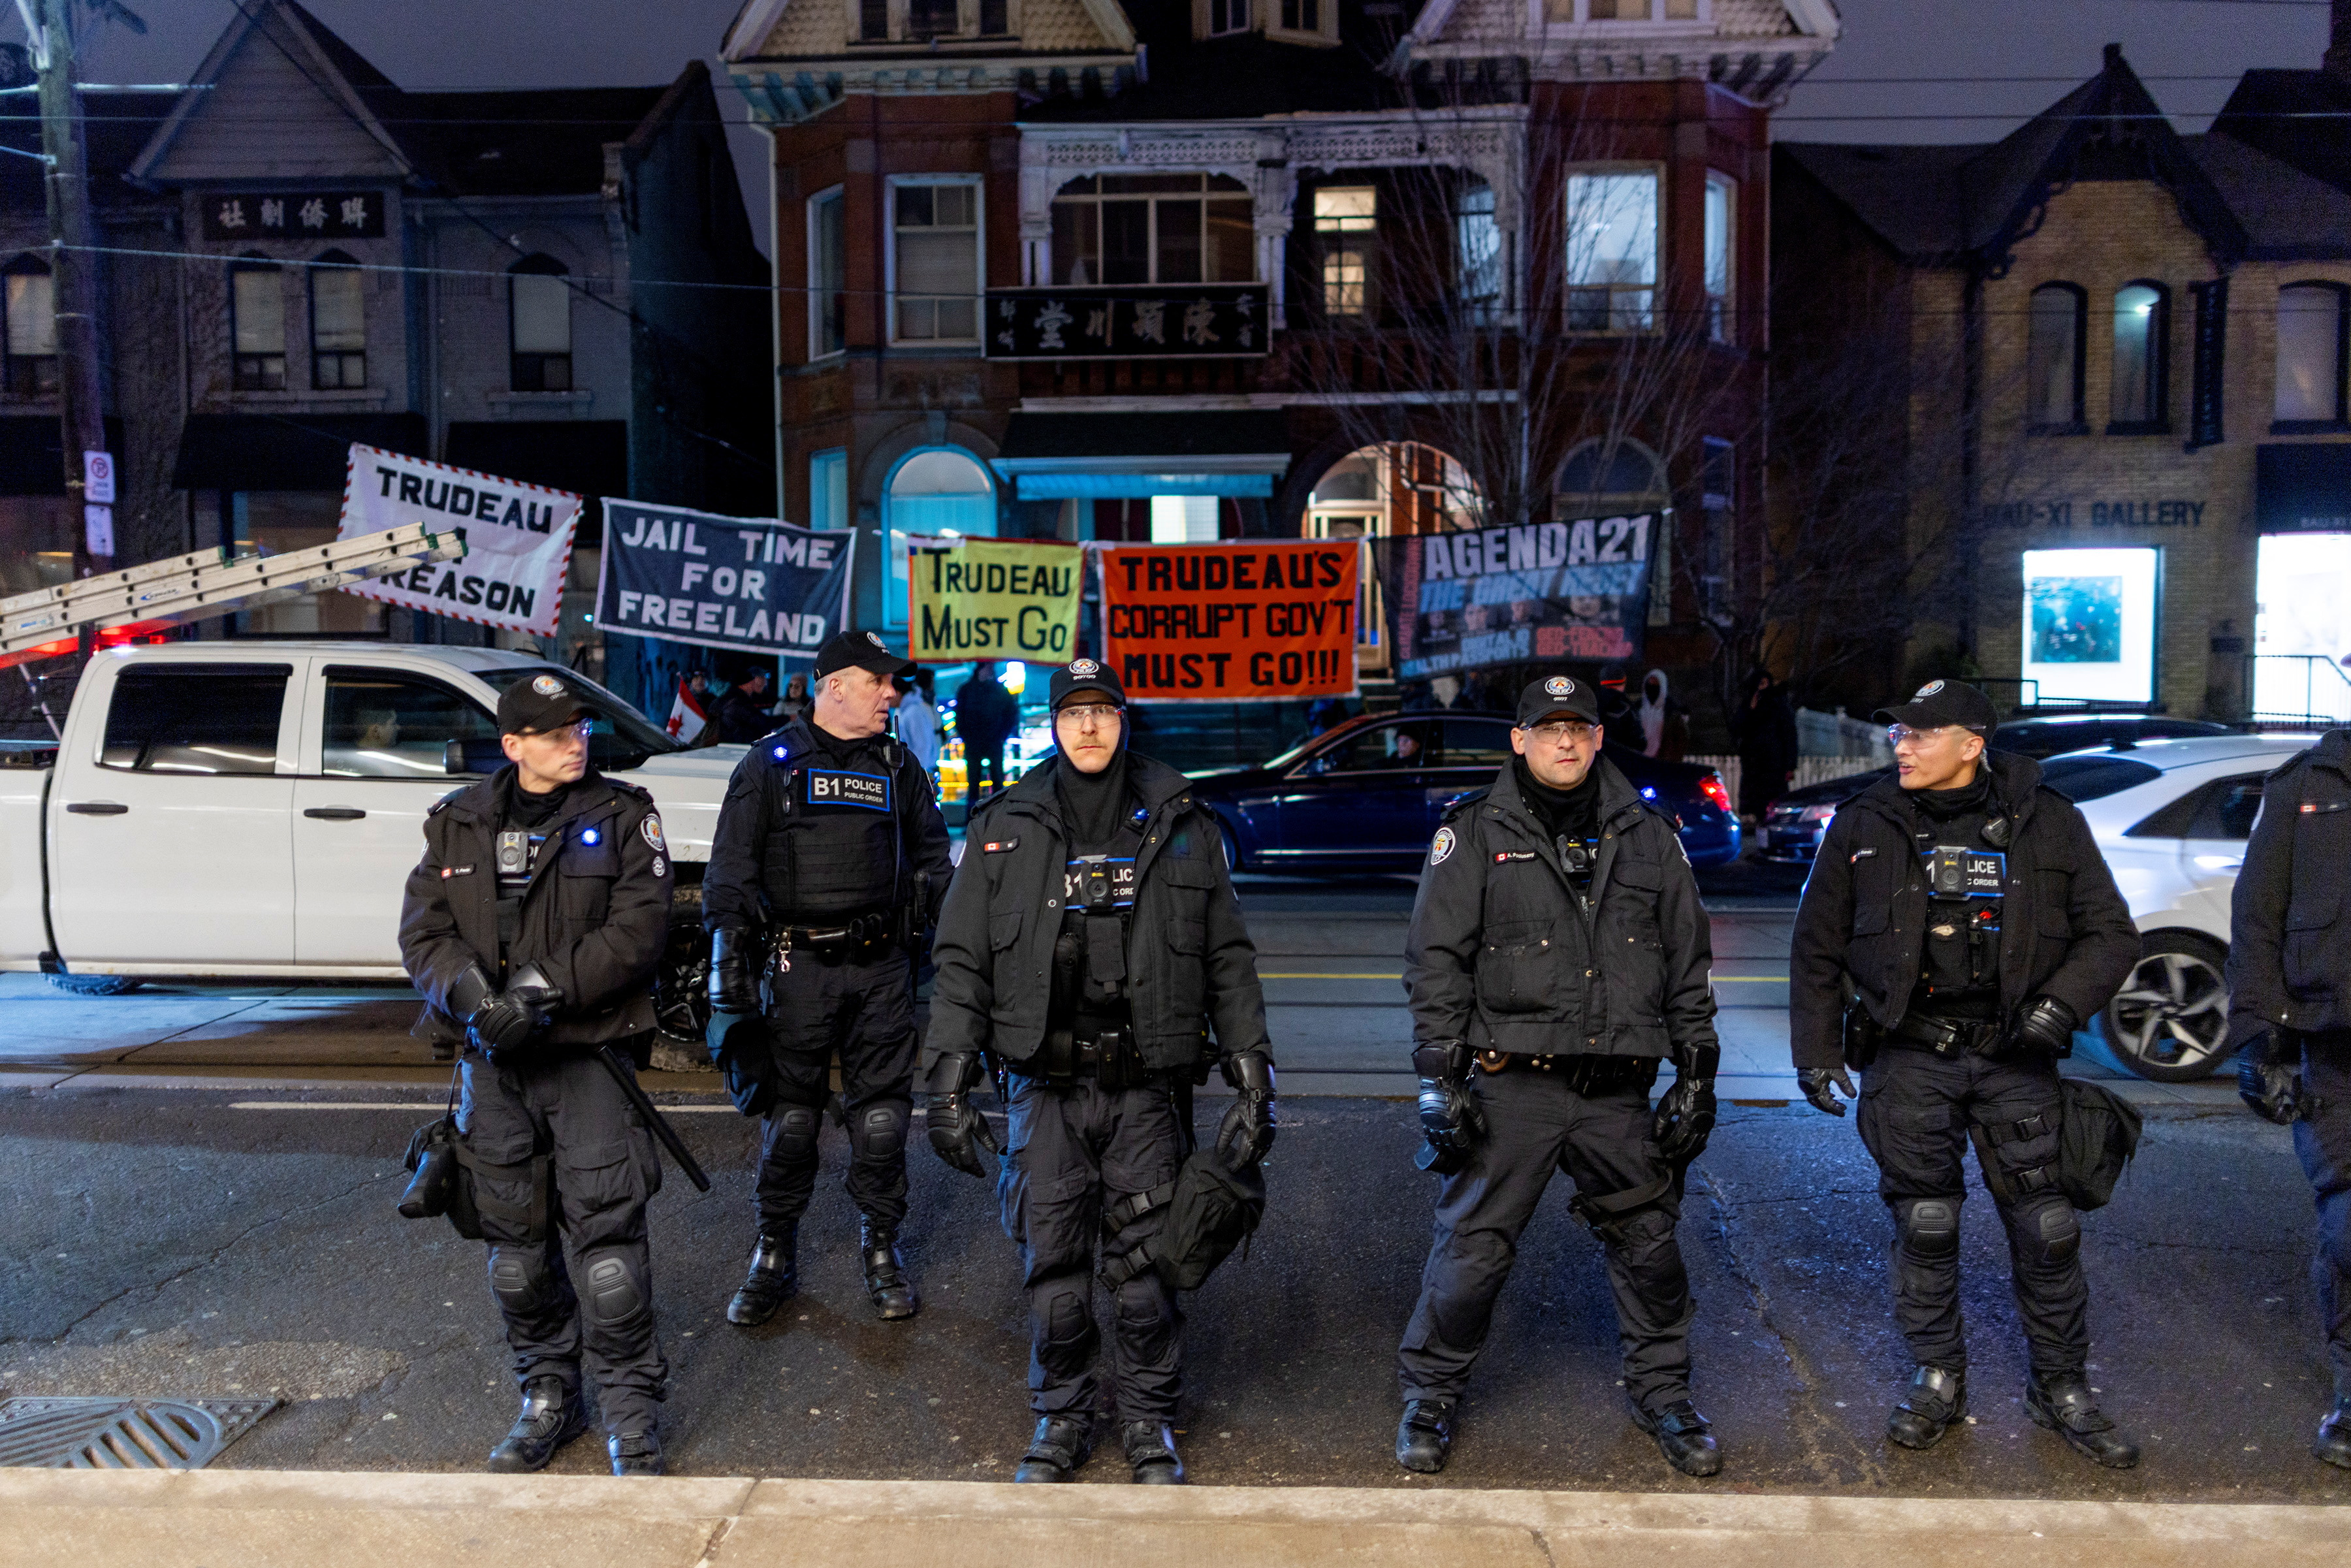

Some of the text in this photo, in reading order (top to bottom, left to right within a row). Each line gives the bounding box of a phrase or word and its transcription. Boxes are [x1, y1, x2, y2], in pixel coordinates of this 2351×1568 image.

[376, 466, 553, 534] TRUDEAU
[2090, 499, 2207, 528] GALLERY
[621, 517, 836, 570] JAIL TIME
[1424, 513, 1653, 581] AGENDA21
[681, 561, 766, 601] FOR
[921, 547, 1071, 598] TRUDEAU
[1118, 551, 1342, 592] TRUDEAU'S
[1418, 579, 1467, 615] THE
[1471, 568, 1558, 607] GREAT
[618, 590, 827, 646] FREELAND
[922, 604, 1067, 652] MUST GO
[1109, 598, 1356, 639] CORRUPT GOV'T
[1123, 648, 1340, 688] MUST GO!!!
[814, 777, 882, 796] B1 POLICE
[844, 792, 884, 804] PUBLIC ORDER
[1112, 868, 1134, 883] LIC
[1966, 859, 1997, 874] LICE
[1973, 878, 2000, 887] ORDER
